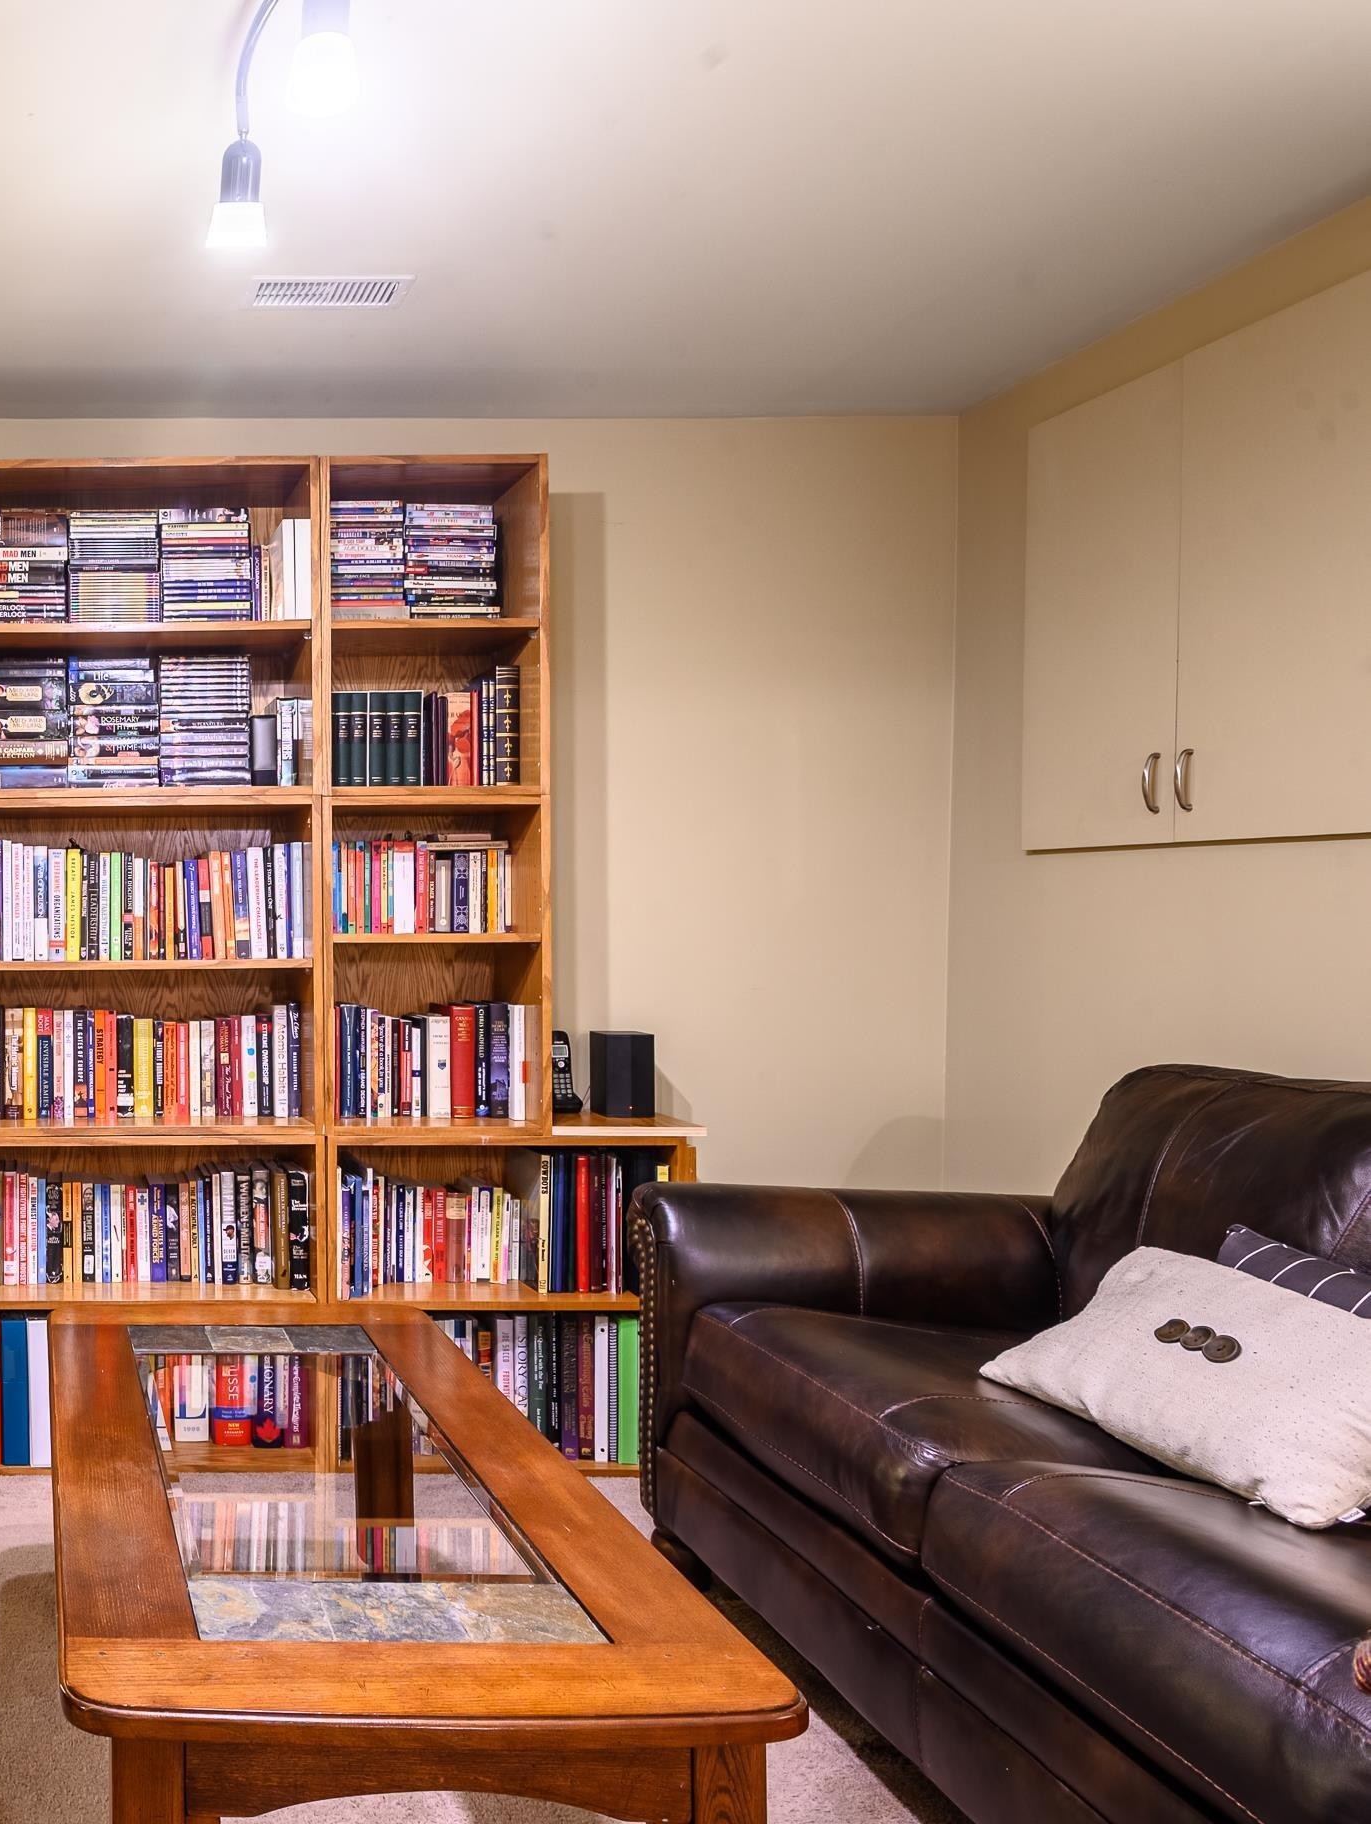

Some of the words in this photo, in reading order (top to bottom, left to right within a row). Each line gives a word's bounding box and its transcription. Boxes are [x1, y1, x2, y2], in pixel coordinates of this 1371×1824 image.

[2, 550, 19, 558] MAD
[20, 550, 37, 558] MEN
[8, 561, 29, 571] MEN
[7, 573, 28, 583] MEN
[53, 861, 61, 893] REFRAMING
[53, 894, 61, 938] ORGANIZATIONS
[90, 893, 98, 941] LEADERSHIP
[96, 1028, 104, 1064] STRATEGY
[261, 1023, 269, 1048] EXTREME
[278, 1022, 286, 1059] Atomic
[77, 1050, 83, 1058] OF
[261, 1049, 269, 1085] OWNERSHIP
[278, 1062, 286, 1094] Habits
[20, 1174, 27, 1183] MY
[502, 1331, 510, 1342] JOE
[502, 1344, 510, 1363] SACCO
[518, 1336, 527, 1377] STORY
